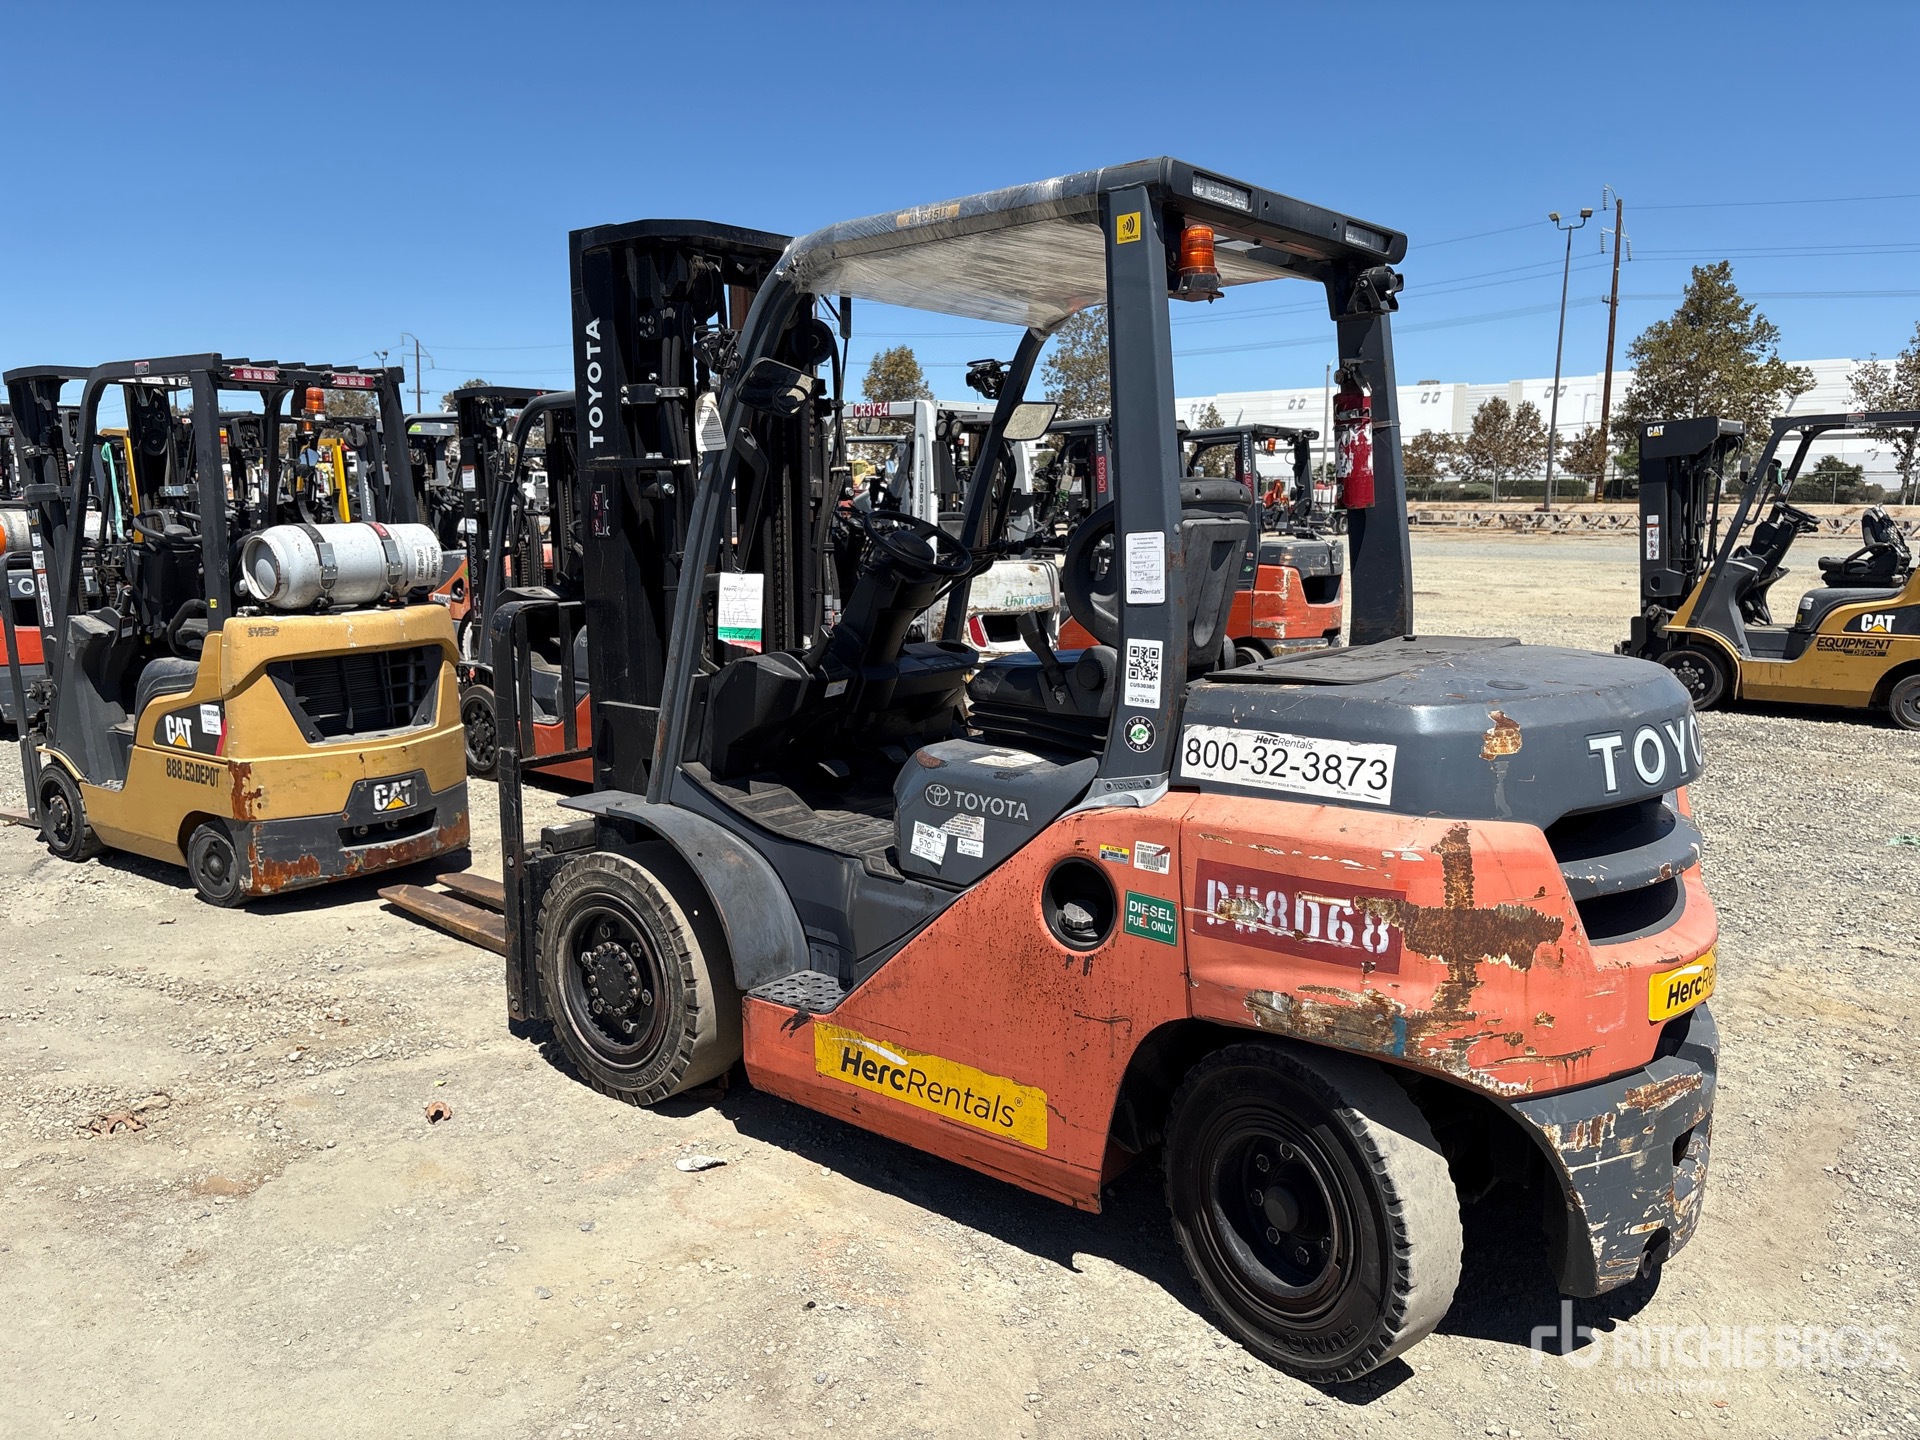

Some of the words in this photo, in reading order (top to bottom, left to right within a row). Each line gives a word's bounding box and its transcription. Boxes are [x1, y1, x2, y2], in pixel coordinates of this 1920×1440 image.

[586, 317, 604, 449] TOYOTA
[854, 402, 888, 417] CR3Y34
[1647, 425, 1664, 437] CAT
[27, 508, 39, 526] CAT
[469, 533, 478, 587] TOYOT
[1861, 613, 1895, 633] CAT
[1816, 637, 1894, 650] EQUIPMENT
[165, 714, 192, 748] CAT
[1129, 717, 1145, 727] TIER
[1129, 740, 1151, 751] FINAL
[1254, 734, 1314, 750] HercRentals
[166, 757, 220, 788] 888.EQDEPOT
[1185, 737, 1388, 791] 800-32-3873
[373, 778, 412, 811] CAT
[1114, 781, 1143, 790] TOYOTA
[953, 790, 1029, 821] TOYOTA
[1129, 900, 1174, 922] DIESEL
[1128, 915, 1149, 929] FUEL
[1151, 920, 1173, 935] ONLY
[1666, 966, 1716, 1010] HercRe
[840, 1046, 1016, 1129] HercRentals
